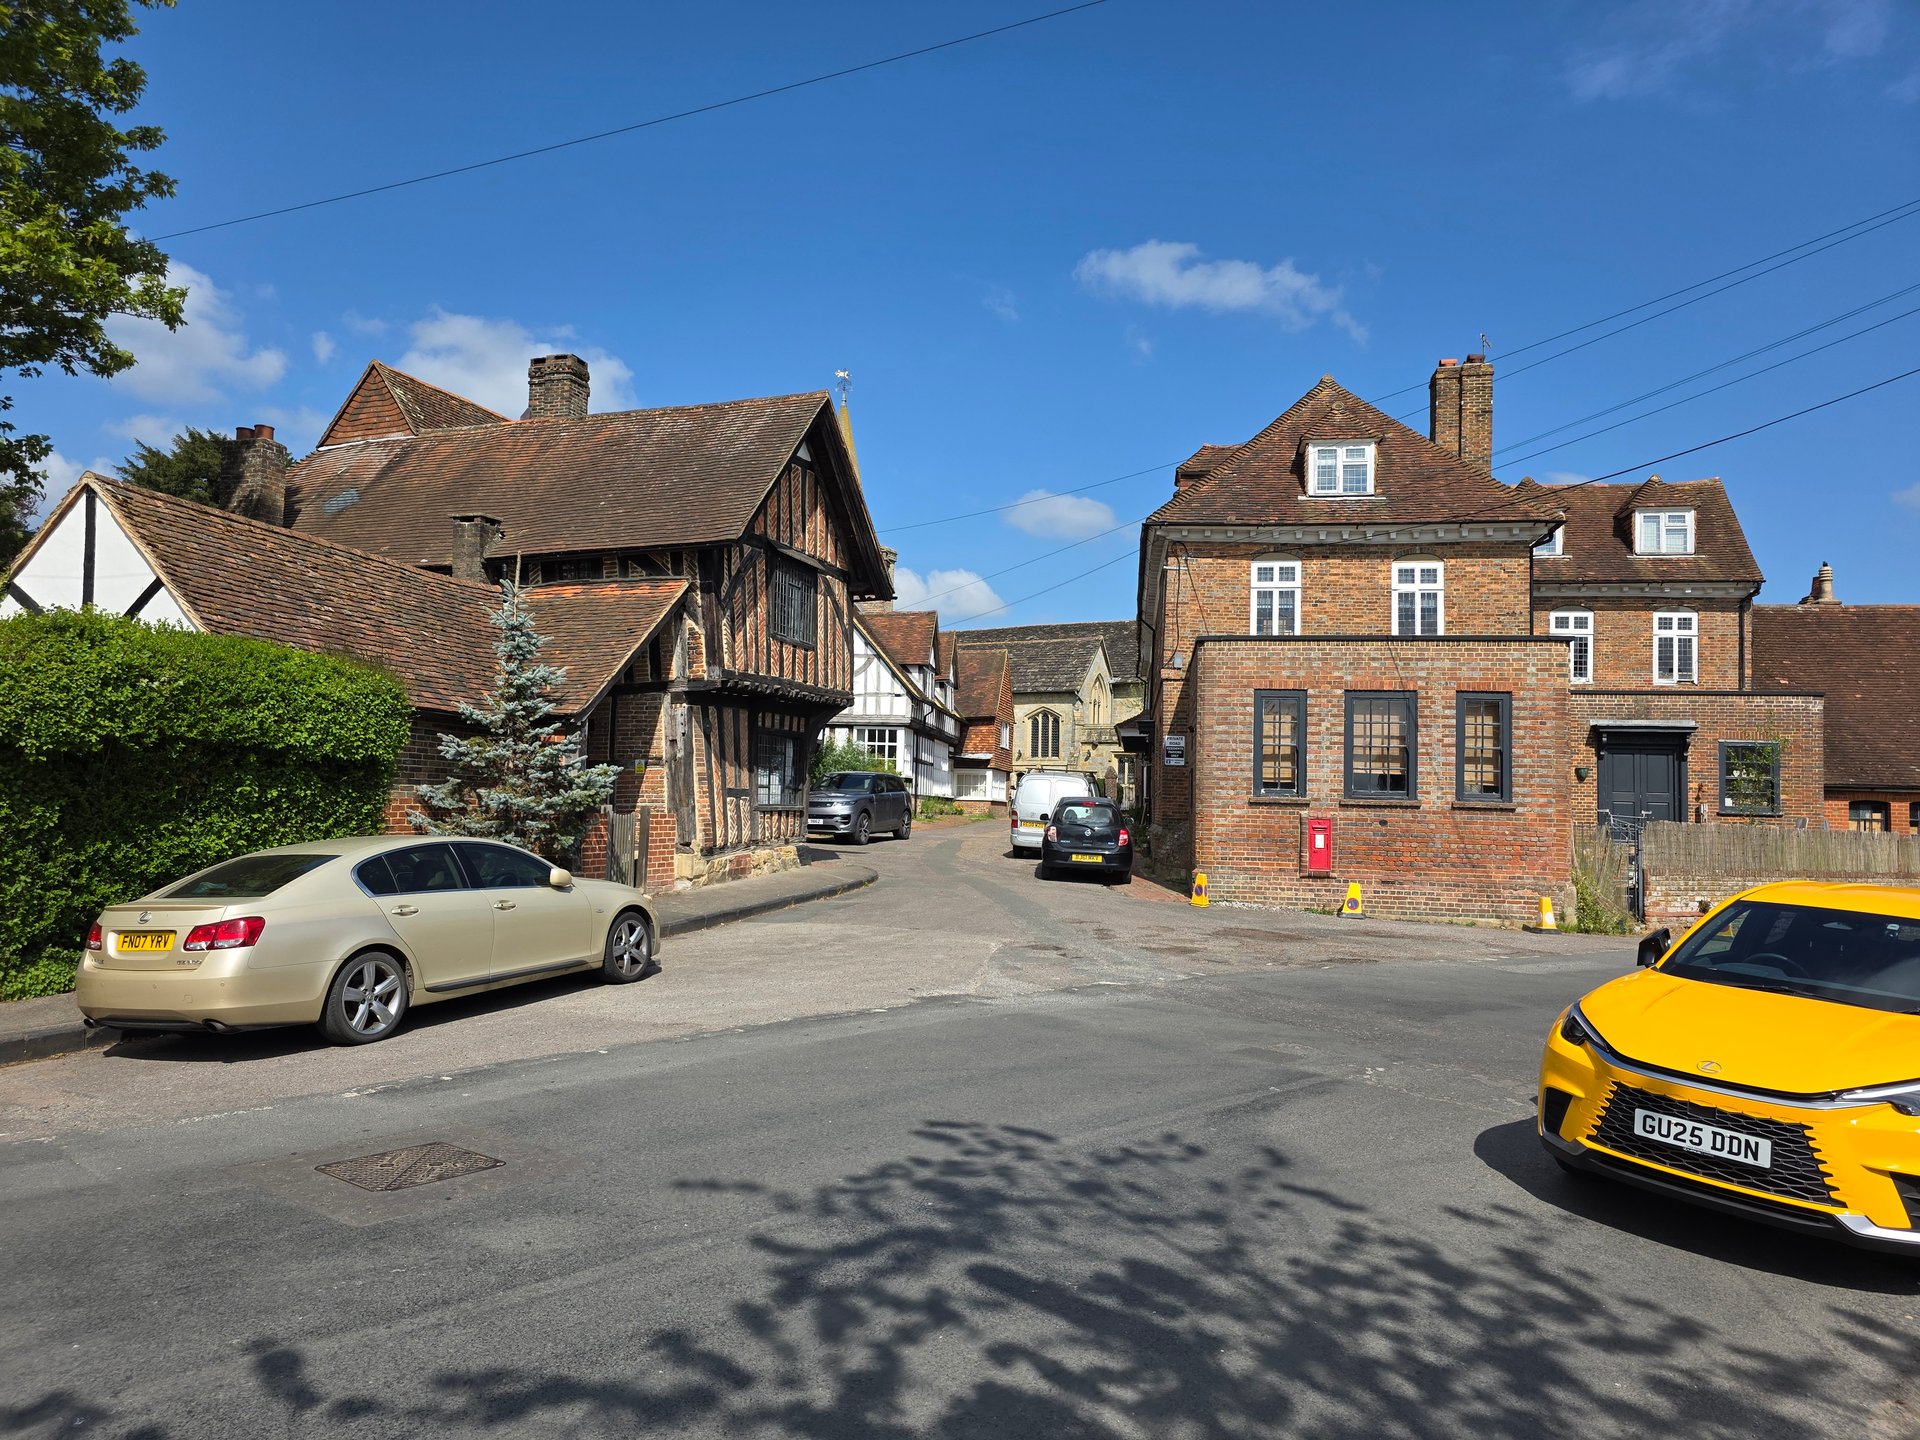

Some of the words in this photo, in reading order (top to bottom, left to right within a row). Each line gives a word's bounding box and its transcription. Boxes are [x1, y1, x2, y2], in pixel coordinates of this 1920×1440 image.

[121, 935, 148, 949] FN07
[150, 935, 170, 949] YRV
[1642, 1114, 1703, 1147] GU25
[1710, 1130, 1760, 1162] DDN
